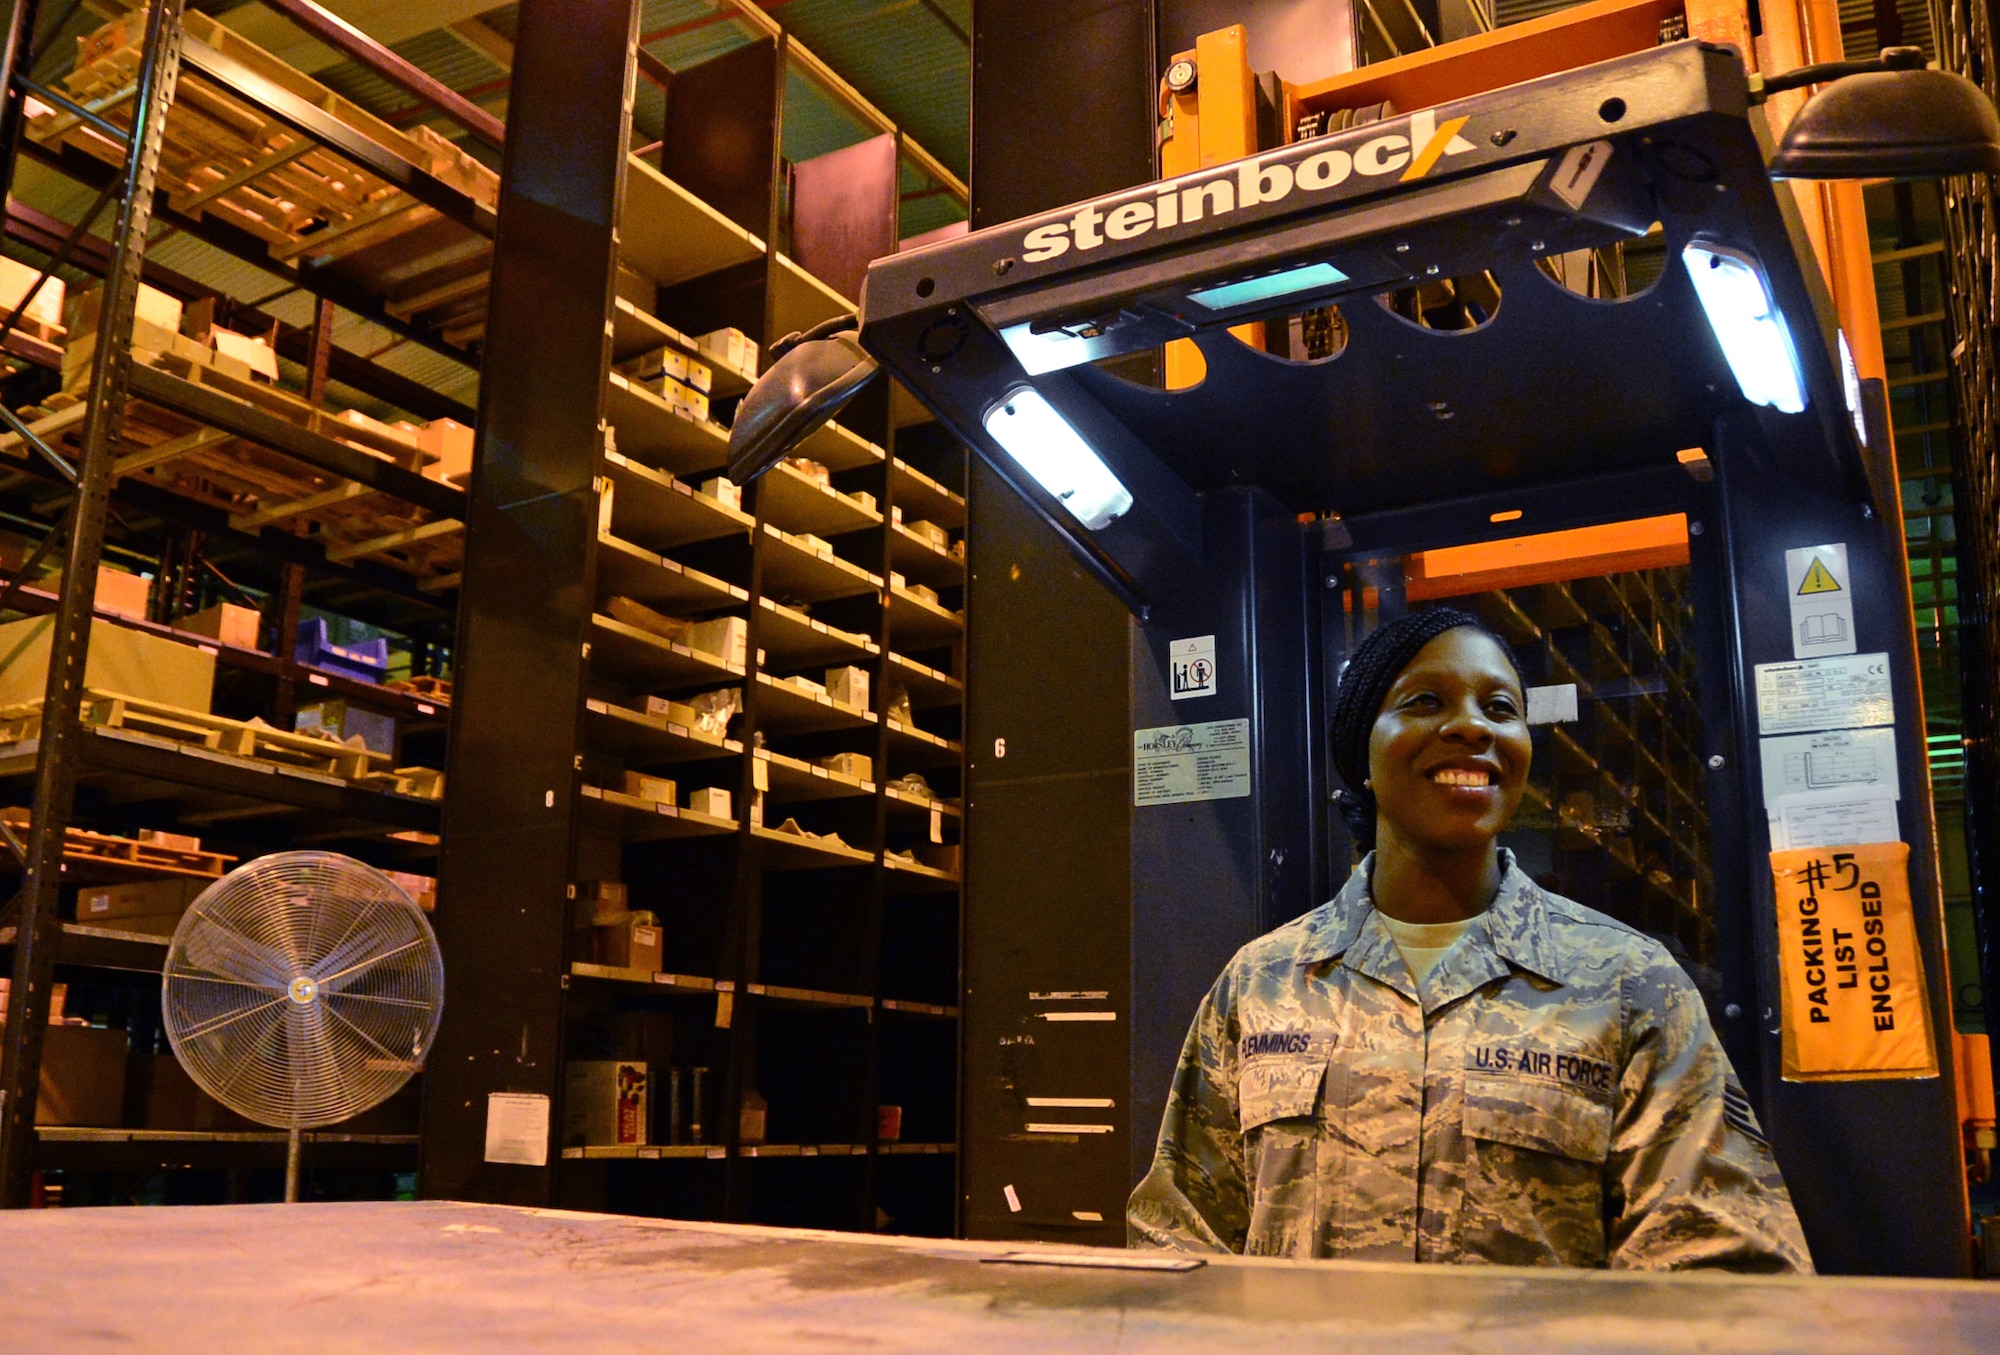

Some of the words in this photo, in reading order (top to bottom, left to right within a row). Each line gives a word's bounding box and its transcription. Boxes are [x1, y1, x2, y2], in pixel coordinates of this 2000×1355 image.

[1022, 109, 1477, 263] steinbock
[994, 737, 1006, 758] 6
[545, 789, 555, 808] 8
[1796, 853, 1860, 896] #5
[1799, 896, 1831, 1024] PACKING
[1832, 928, 1858, 989] LIST
[1860, 881, 1895, 1031] ENCLOSED
[1475, 1047, 1513, 1070] U.S.
[1518, 1049, 1552, 1075] AIR
[1556, 1054, 1612, 1088] FORCE
